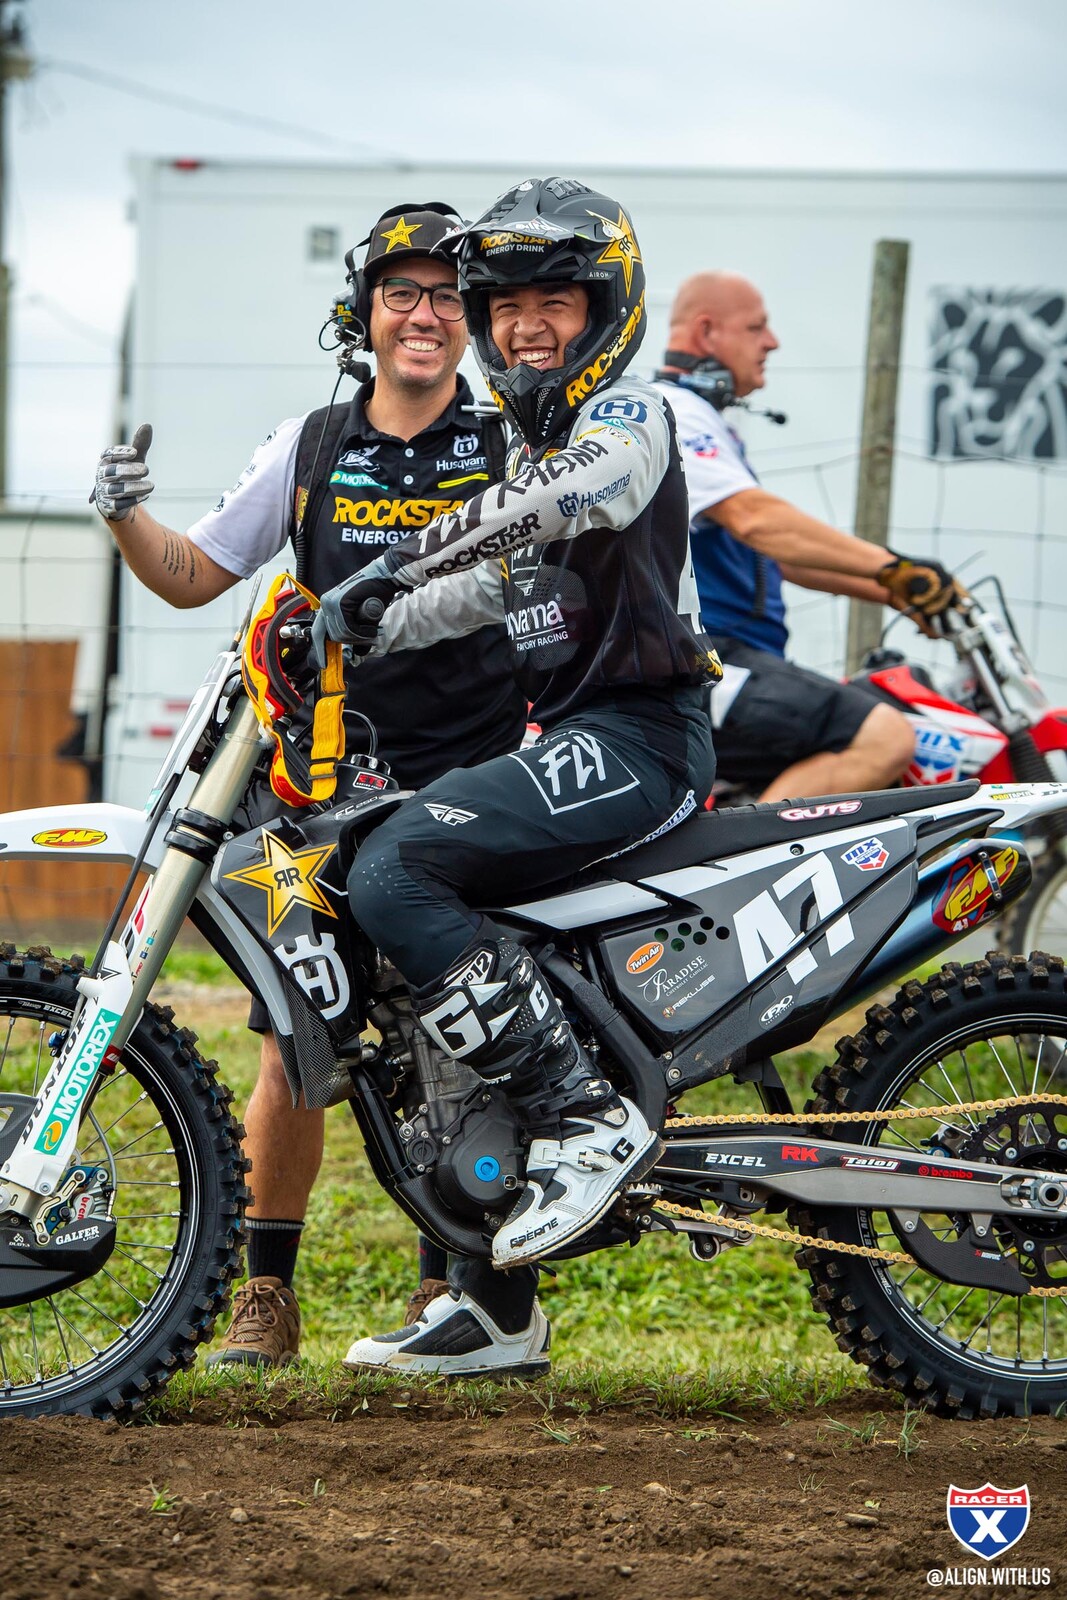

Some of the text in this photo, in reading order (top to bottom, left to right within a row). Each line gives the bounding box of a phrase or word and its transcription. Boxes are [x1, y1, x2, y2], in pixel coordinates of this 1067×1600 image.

[486, 243, 545, 257] ENERGY DRINK
[588, 270, 609, 279] AIROH
[541, 405, 555, 437] AIROH
[436, 456, 487, 471] Husqvarn
[579, 473, 631, 510] Husqvarna
[332, 496, 465, 527] ROCKSTA
[424, 512, 542, 579] ROCKSTAR
[537, 630, 569, 647] RACING
[538, 735, 606, 796] FLY
[358, 774, 386, 788] ETS
[780, 801, 862, 820] GUTS
[34, 830, 106, 844] FMF
[733, 851, 855, 985] 47
[630, 944, 661, 972] Twin Air
[637, 955, 706, 1003] PARADISE
[666, 978, 689, 997] CHEVROLET
[529, 980, 550, 1021] G
[672, 974, 716, 1011] REKLUSE
[43, 1004, 74, 1018] EXCEL
[420, 990, 487, 1060] G
[22, 1008, 87, 1145] DUNLOP
[53, 1015, 117, 1122] MOTOREX
[704, 1152, 767, 1168] EXCEL
[781, 1145, 820, 1162] RK
[843, 1156, 899, 1170] Talon
[931, 1167, 974, 1180] brembo
[55, 1225, 100, 1246] GALFER
[82, 1234, 100, 1242] USA
[509, 1217, 559, 1249] GAERNE
